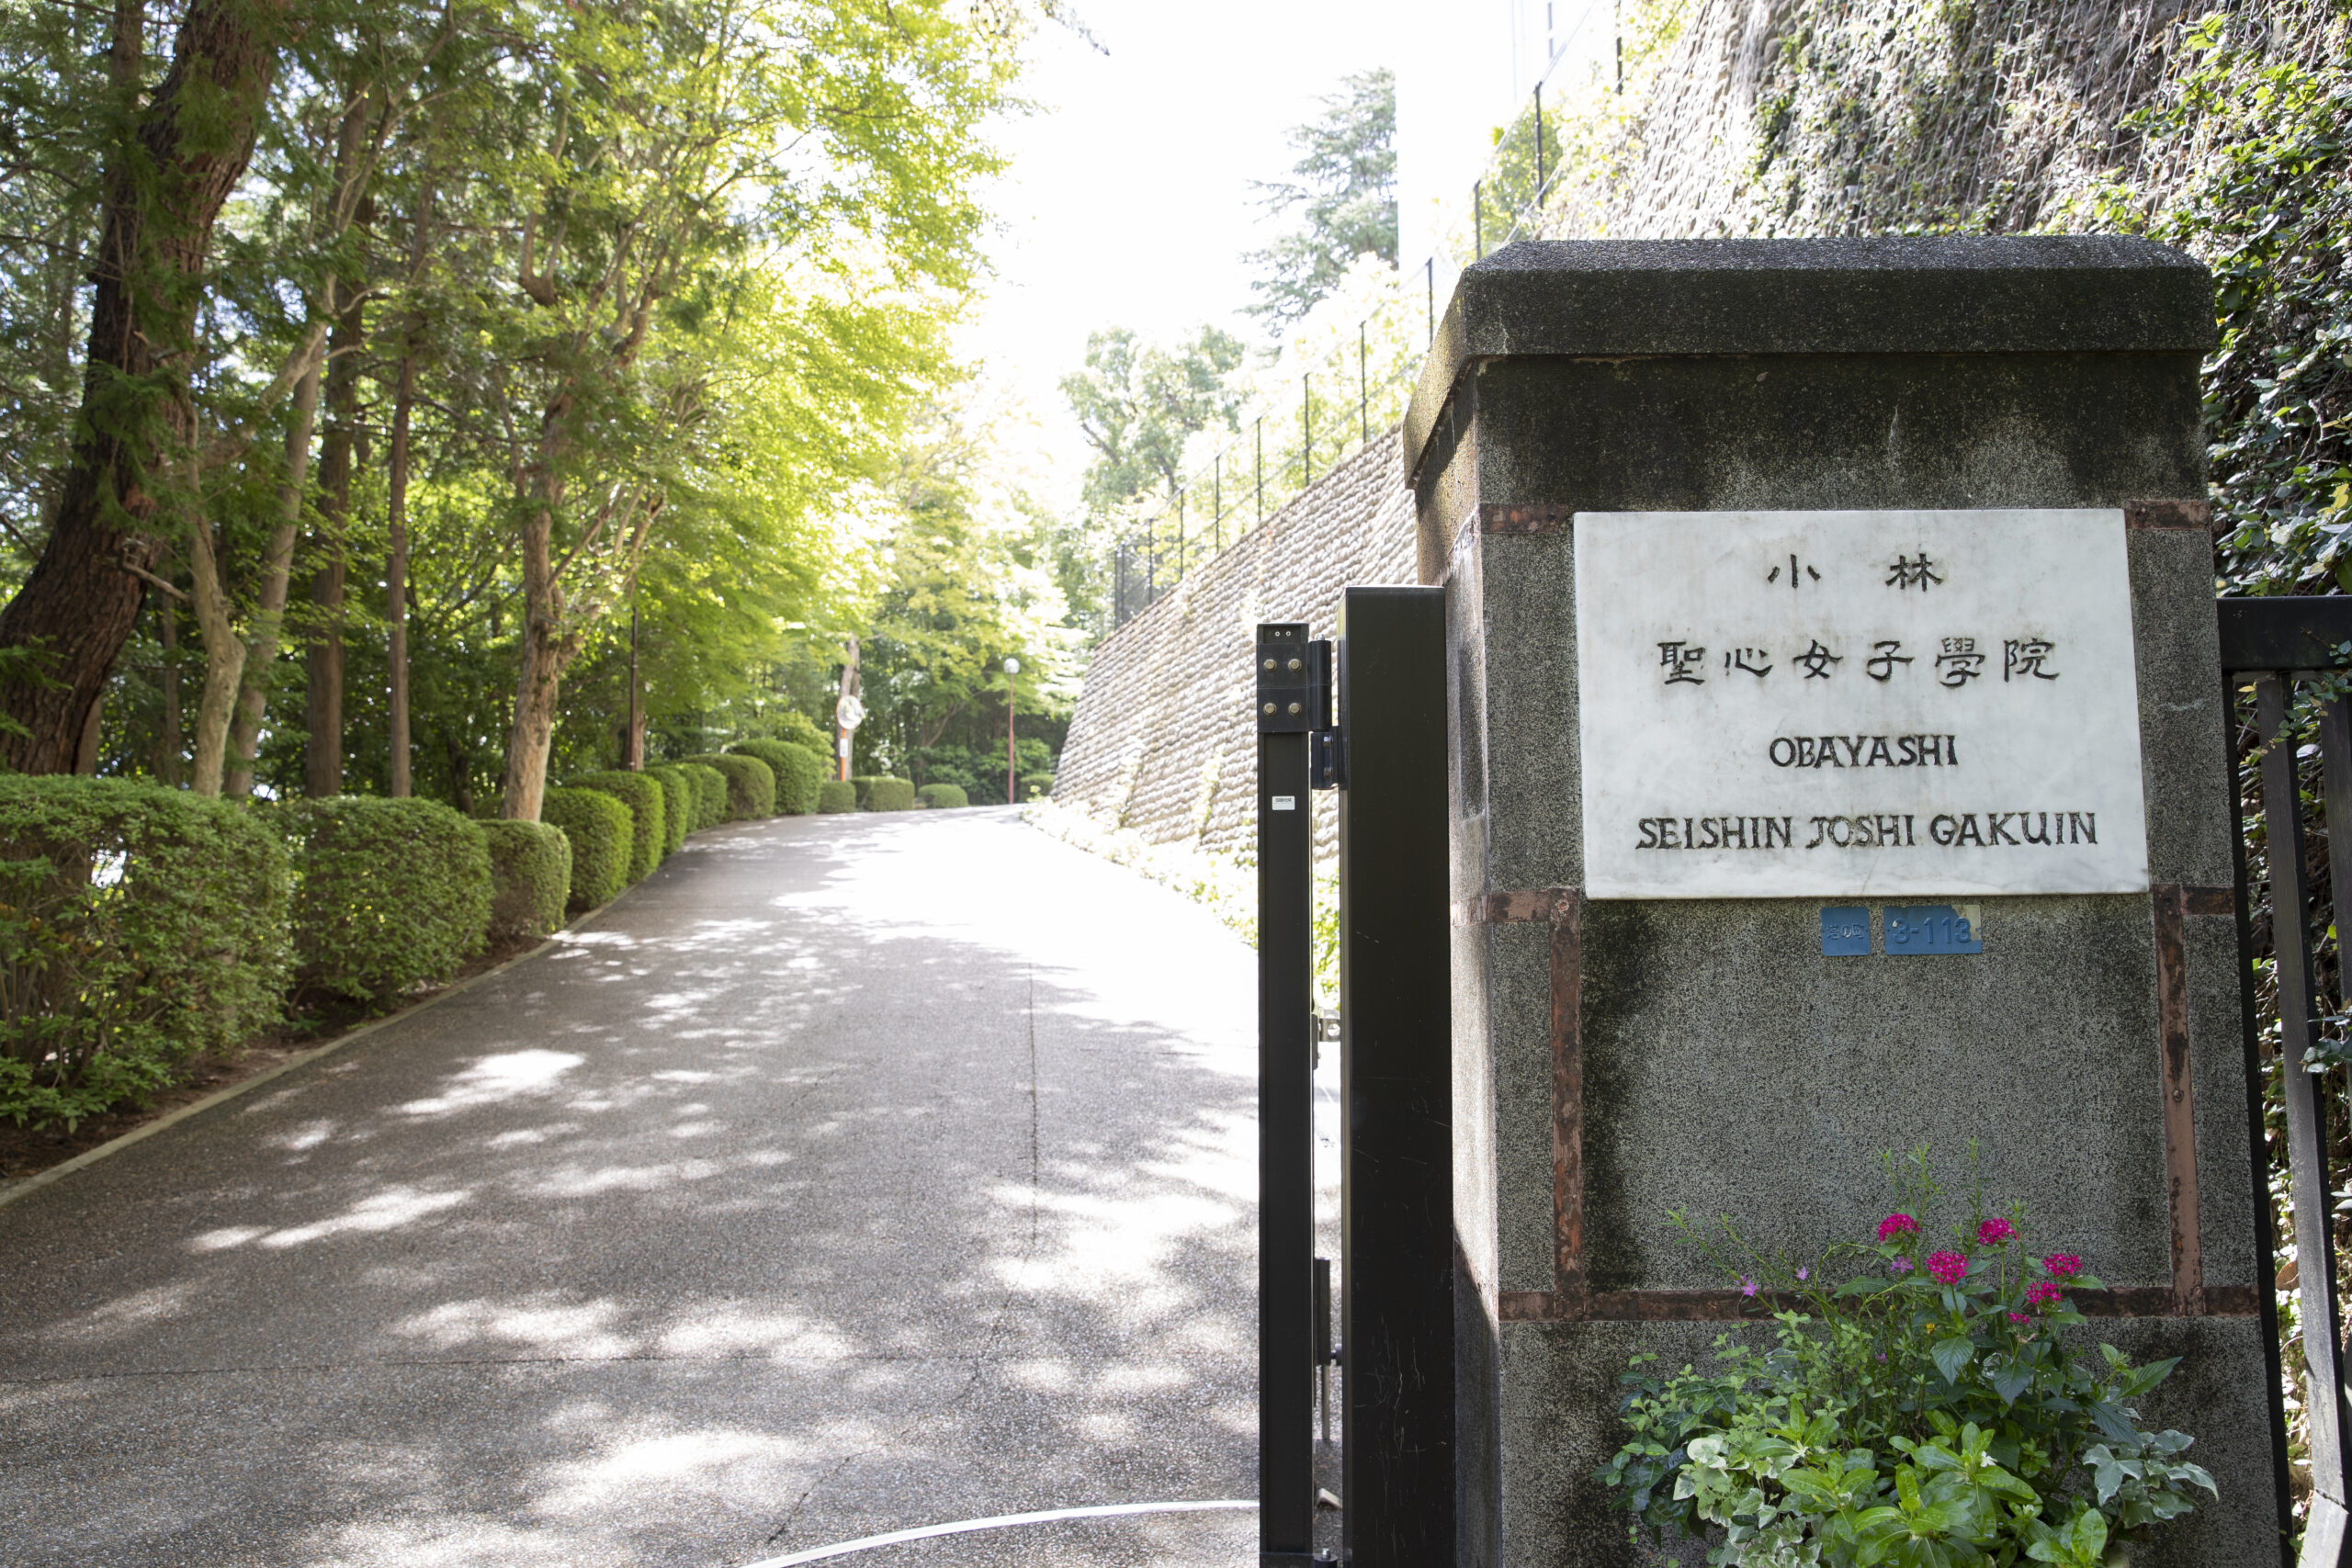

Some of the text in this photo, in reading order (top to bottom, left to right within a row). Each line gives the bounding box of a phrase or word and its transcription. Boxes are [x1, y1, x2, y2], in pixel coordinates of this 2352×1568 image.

[1767, 553, 1943, 592] 小林
[1657, 637, 2059, 688] 聖心女子學院
[1769, 734, 1959, 769] OBAYASHI
[1635, 811, 2098, 850] SEISHIN JOSHI GAKUIN
[1893, 917, 1972, 944] 3-113
